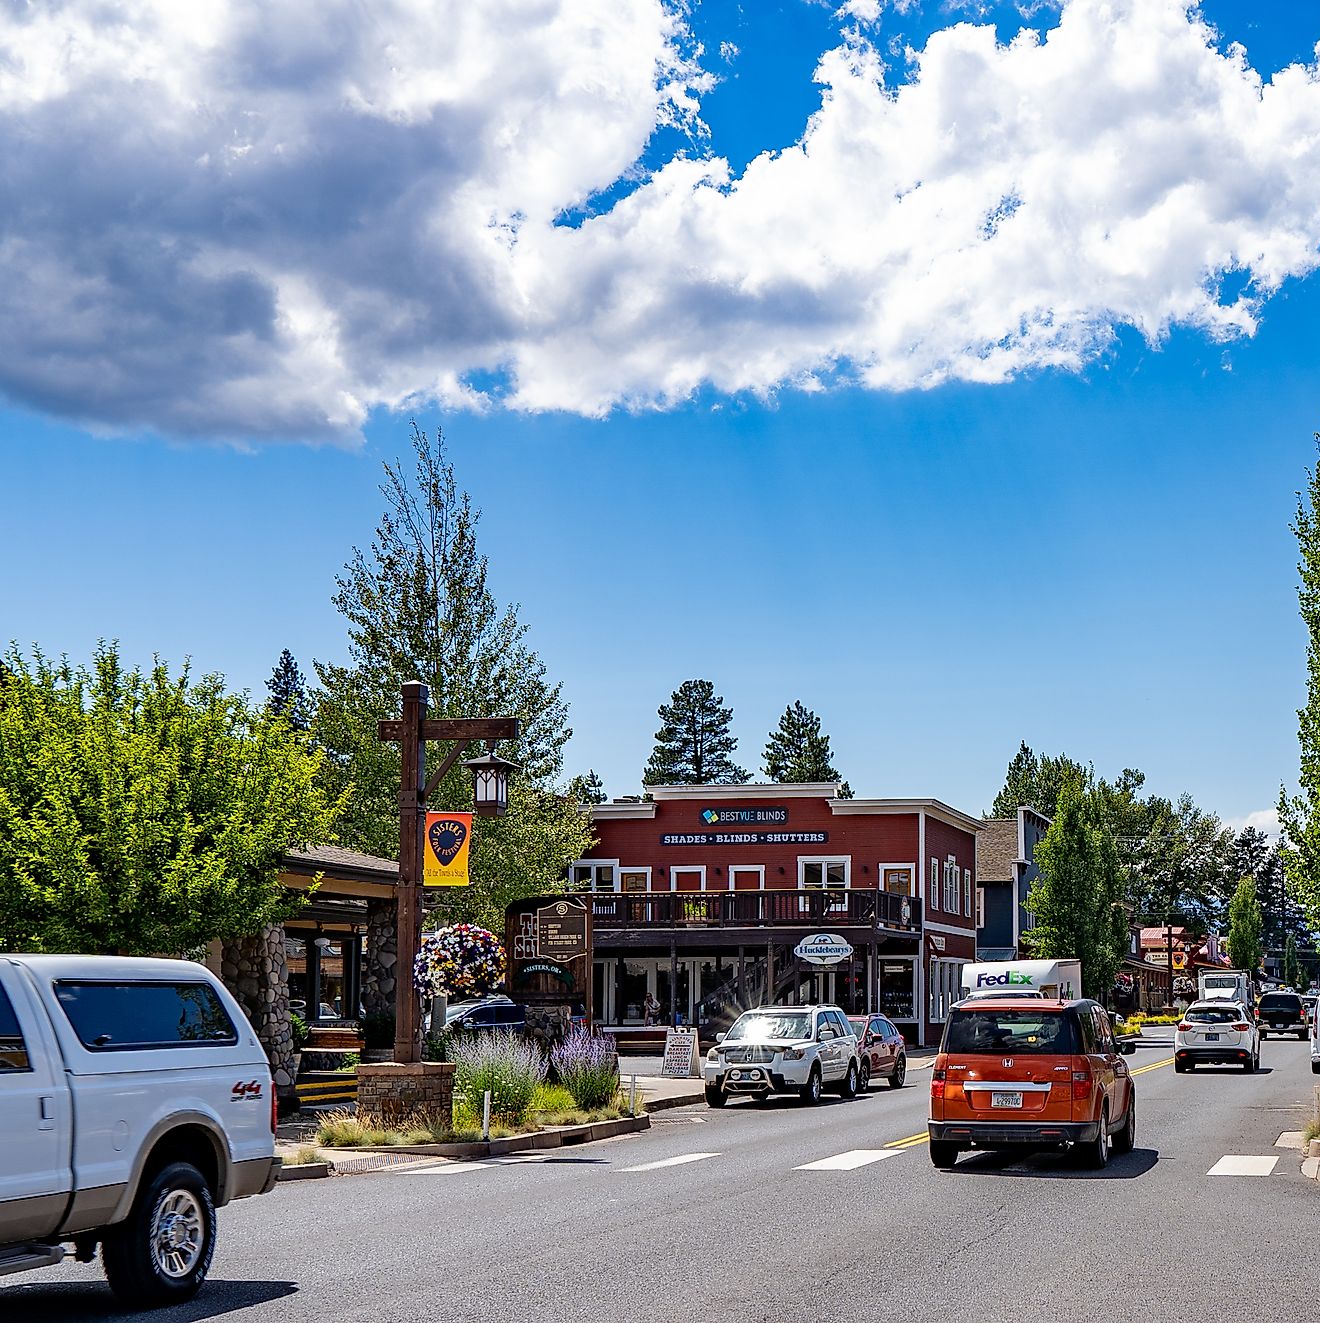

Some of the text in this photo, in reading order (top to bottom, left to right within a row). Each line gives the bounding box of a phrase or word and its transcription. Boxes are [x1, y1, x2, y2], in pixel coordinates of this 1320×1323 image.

[757, 811, 786, 821] BLINDS
[432, 822, 462, 836] SISTERS
[664, 833, 825, 844] SHADES BLINDS SHUTTERS
[432, 838, 462, 856] FOLK FESTIVAL
[550, 966, 560, 974] OR
[977, 971, 1033, 987] FedEx
